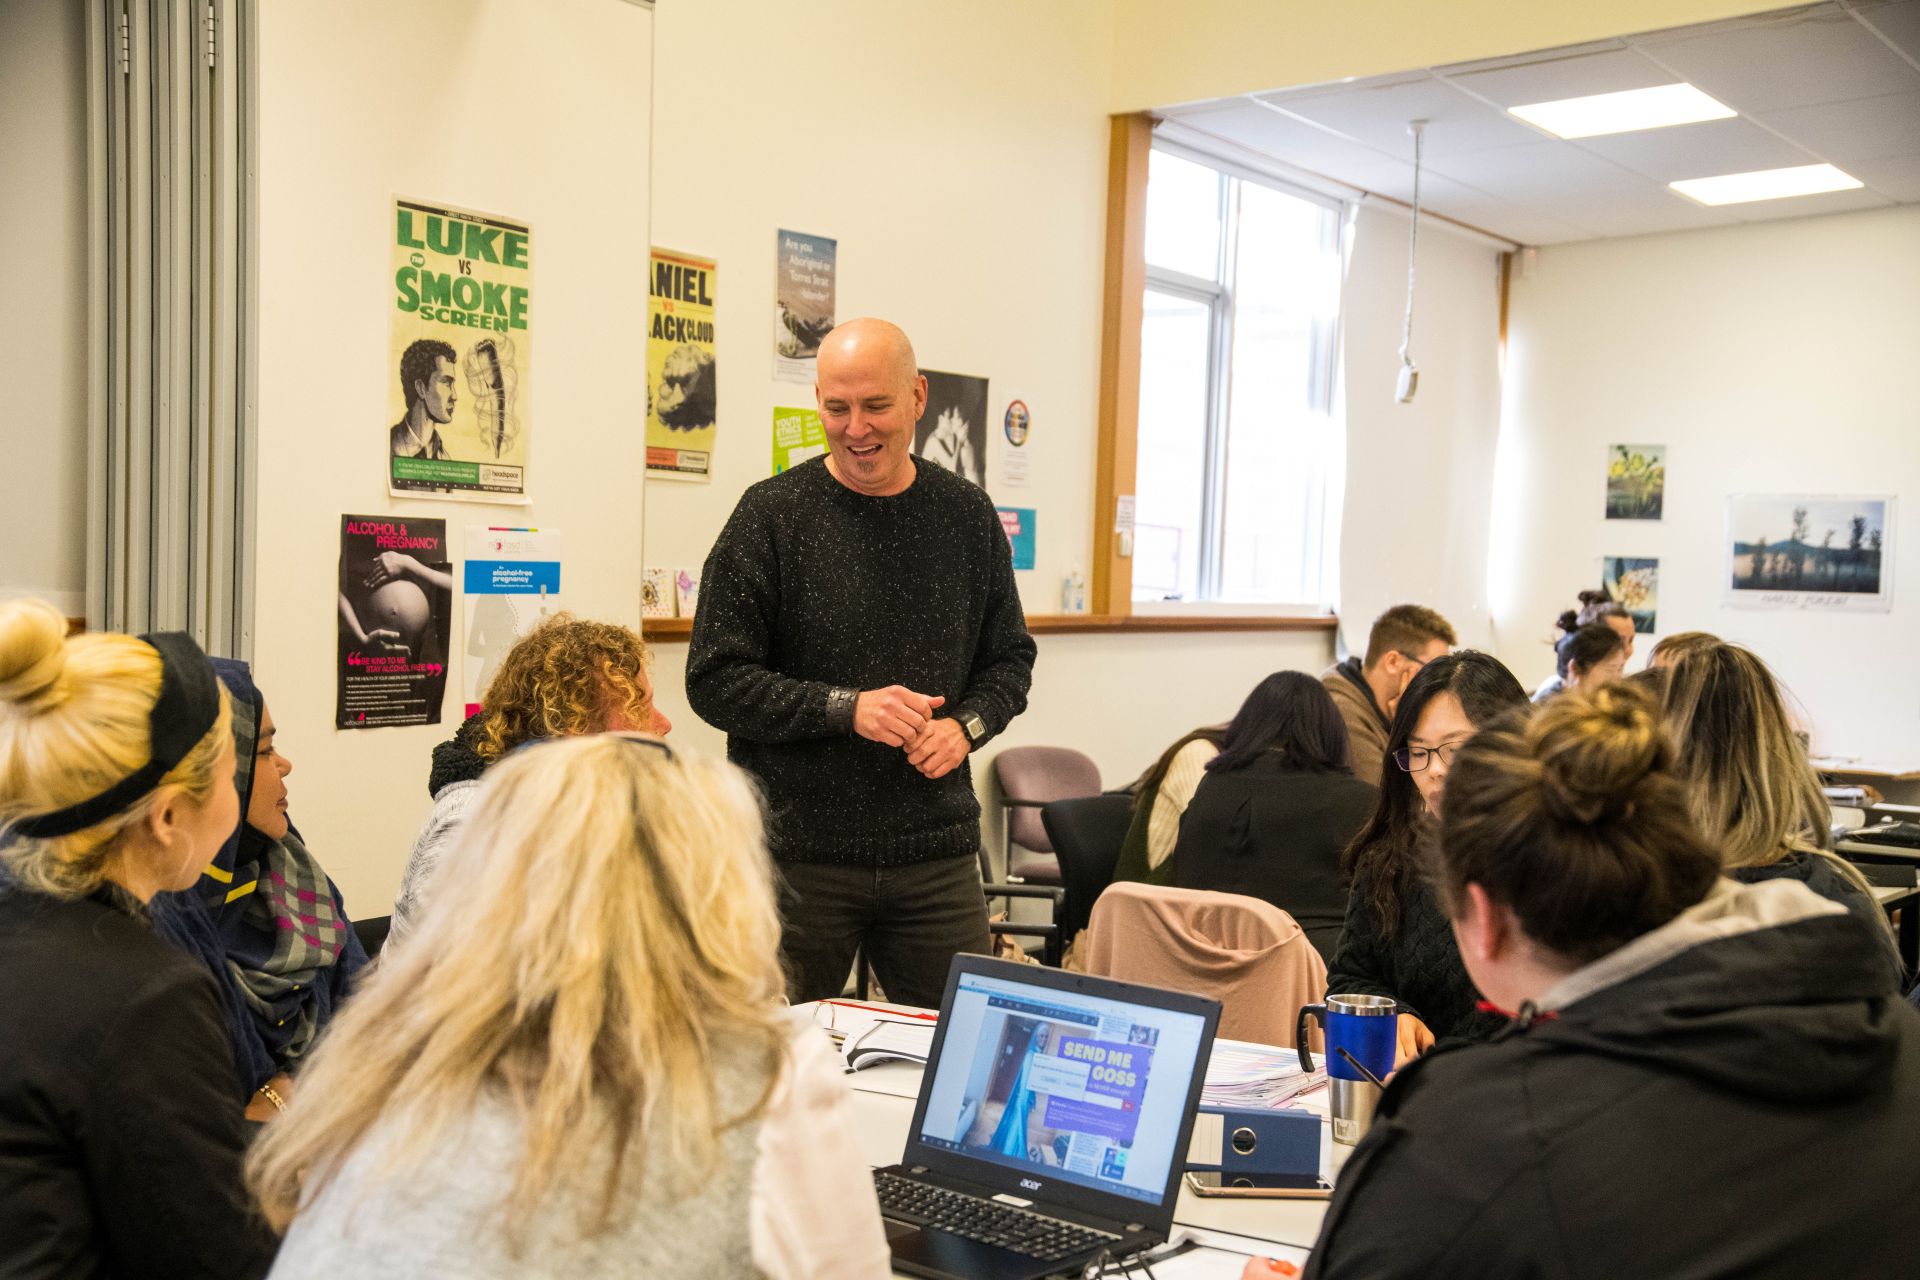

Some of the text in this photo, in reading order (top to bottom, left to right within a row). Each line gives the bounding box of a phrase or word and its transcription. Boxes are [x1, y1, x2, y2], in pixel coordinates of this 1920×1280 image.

[397, 209, 529, 269] LUKE
[785, 237, 813, 253] Are you
[459, 259, 472, 276] VS
[396, 266, 529, 330] SMOKE
[420, 305, 509, 333] SCREEN
[649, 313, 714, 343] ACK CLOUD
[346, 522, 407, 535] ALCOHOL &
[376, 536, 438, 549] PREGNANCY
[493, 569, 533, 577] alcohol-free
[493, 576, 529, 584] pregnancy
[366, 665, 380, 673] STAY
[382, 665, 410, 673] ALCOHOL
[1064, 1041, 1133, 1069] SEND ME
[1092, 1065, 1137, 1088] GOSS
[1020, 1178, 1042, 1190] acer
